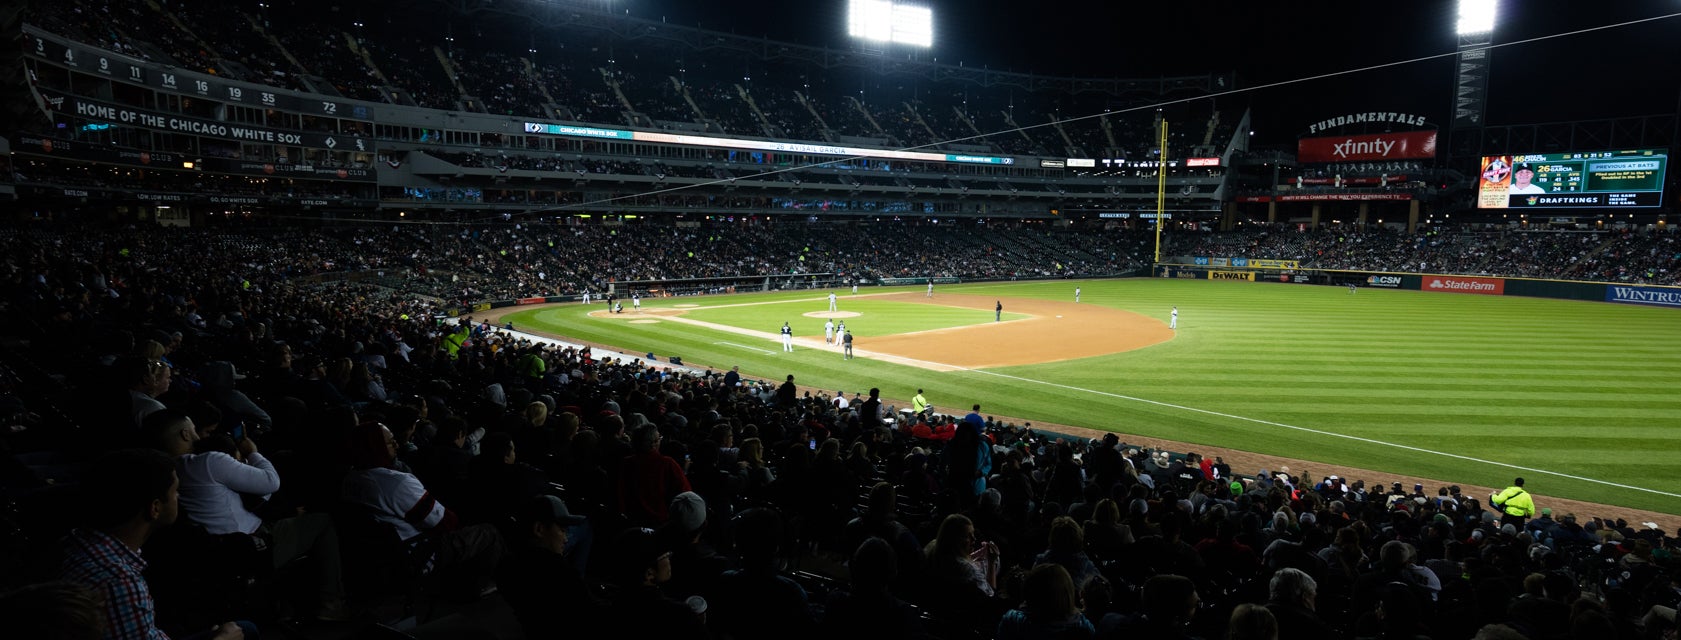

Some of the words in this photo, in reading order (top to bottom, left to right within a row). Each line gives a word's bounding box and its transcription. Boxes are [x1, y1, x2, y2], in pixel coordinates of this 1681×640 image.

[36, 38, 46, 51] 3
[65, 48, 74, 61] 4
[100, 57, 108, 70] 9
[130, 66, 141, 78] 11
[162, 73, 176, 85] 14
[196, 80, 208, 92] 16
[228, 87, 242, 97] 19
[262, 92, 275, 103] 35
[322, 102, 336, 112] 72
[77, 102, 116, 119] HOME
[120, 110, 137, 123] OF
[140, 114, 165, 128] THE
[170, 119, 226, 136] CHICAGO
[231, 127, 274, 141] WHITE
[278, 132, 302, 144] SOX
[1309, 112, 1426, 134] FUNDAMENTALS
[1333, 138, 1396, 158] xfinity
